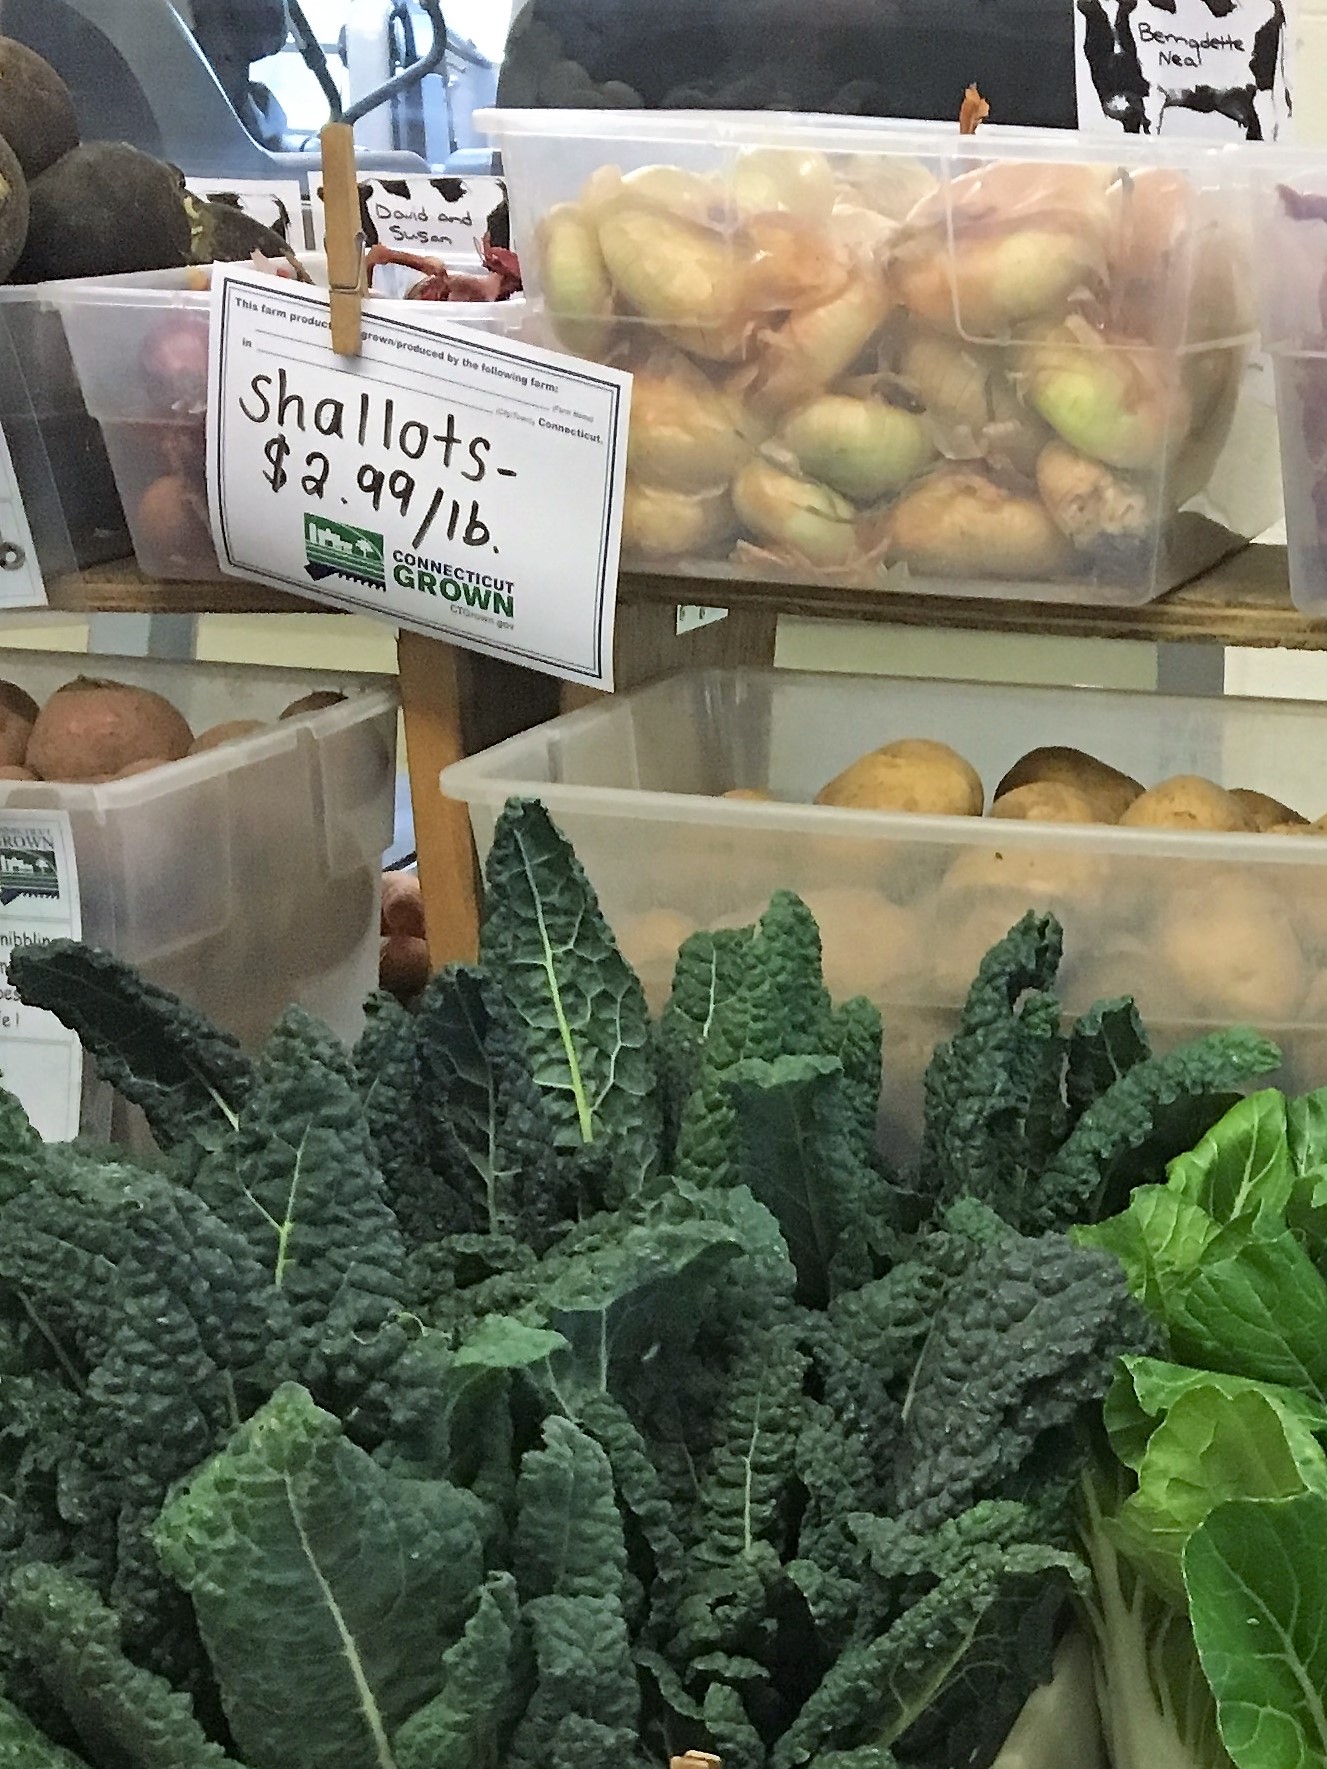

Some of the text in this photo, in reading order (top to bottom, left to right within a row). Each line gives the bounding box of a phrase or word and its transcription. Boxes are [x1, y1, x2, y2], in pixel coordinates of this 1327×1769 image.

[1138, 22, 1244, 51] Bernadette
[438, 211, 473, 226] and
[235, 297, 258, 311] This
[262, 305, 286, 318] farm
[290, 313, 332, 329] produc
[447, 354, 459, 366] by
[463, 357, 479, 370] the
[482, 363, 528, 385] following
[531, 377, 558, 393] farm:
[242, 338, 603, 445] in Connecticut.
[393, 550, 514, 594] CONNECTICUT
[394, 565, 514, 618] GROWN
